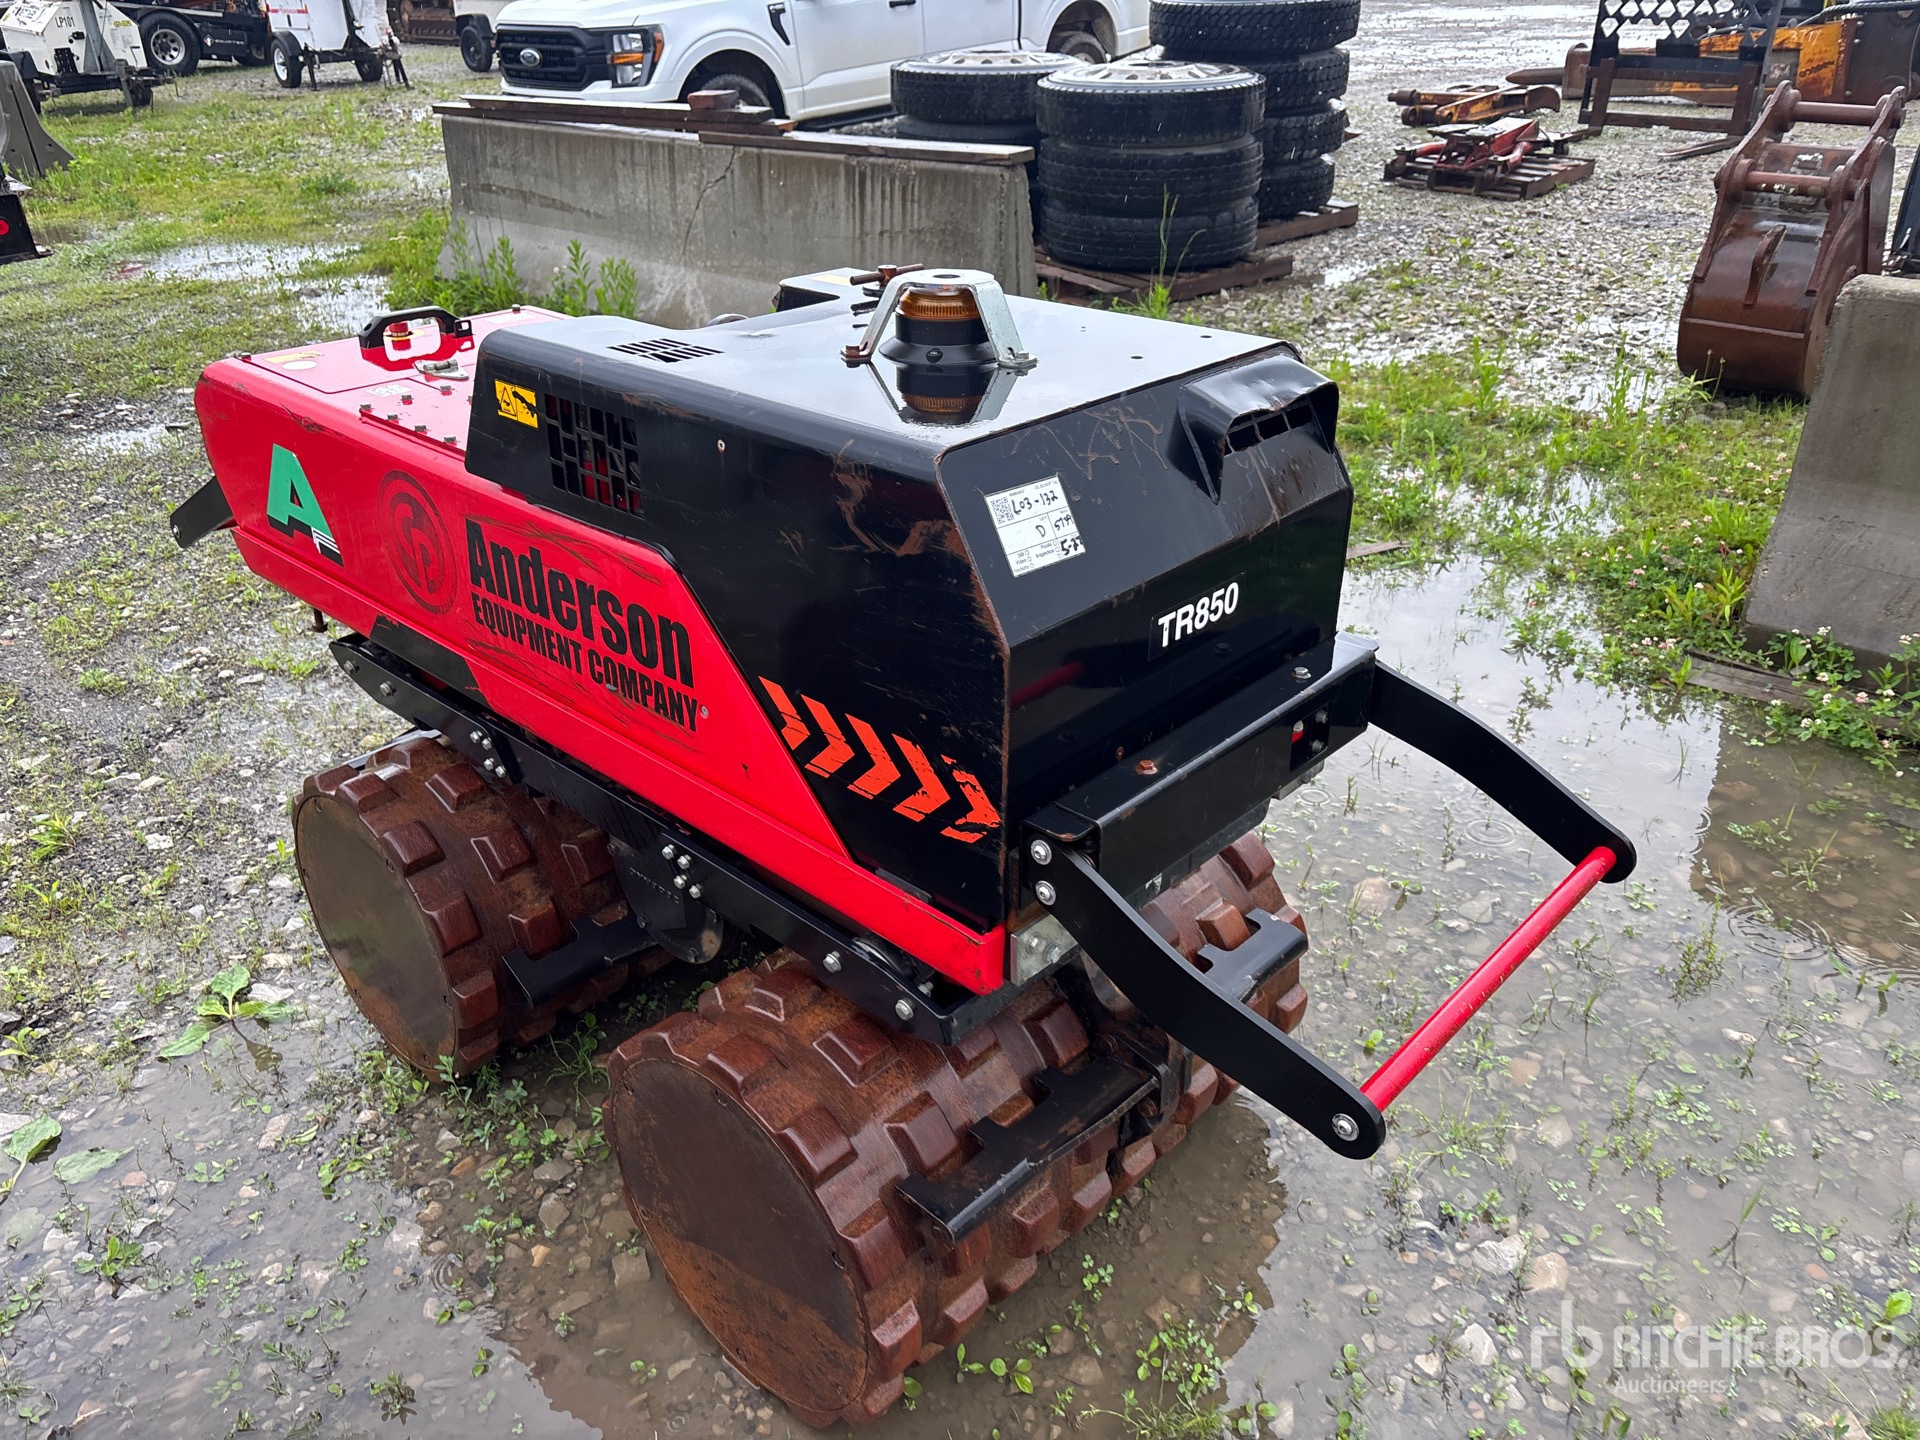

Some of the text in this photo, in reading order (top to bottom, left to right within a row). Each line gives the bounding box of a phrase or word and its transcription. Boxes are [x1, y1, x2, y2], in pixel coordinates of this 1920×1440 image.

[55, 16, 76, 28] LP101
[1012, 490, 1058, 514] L03-132
[465, 518, 694, 689] Anderson
[1157, 582, 1239, 648] TR850
[471, 592, 698, 732] EQUIPMENT COMPANY
